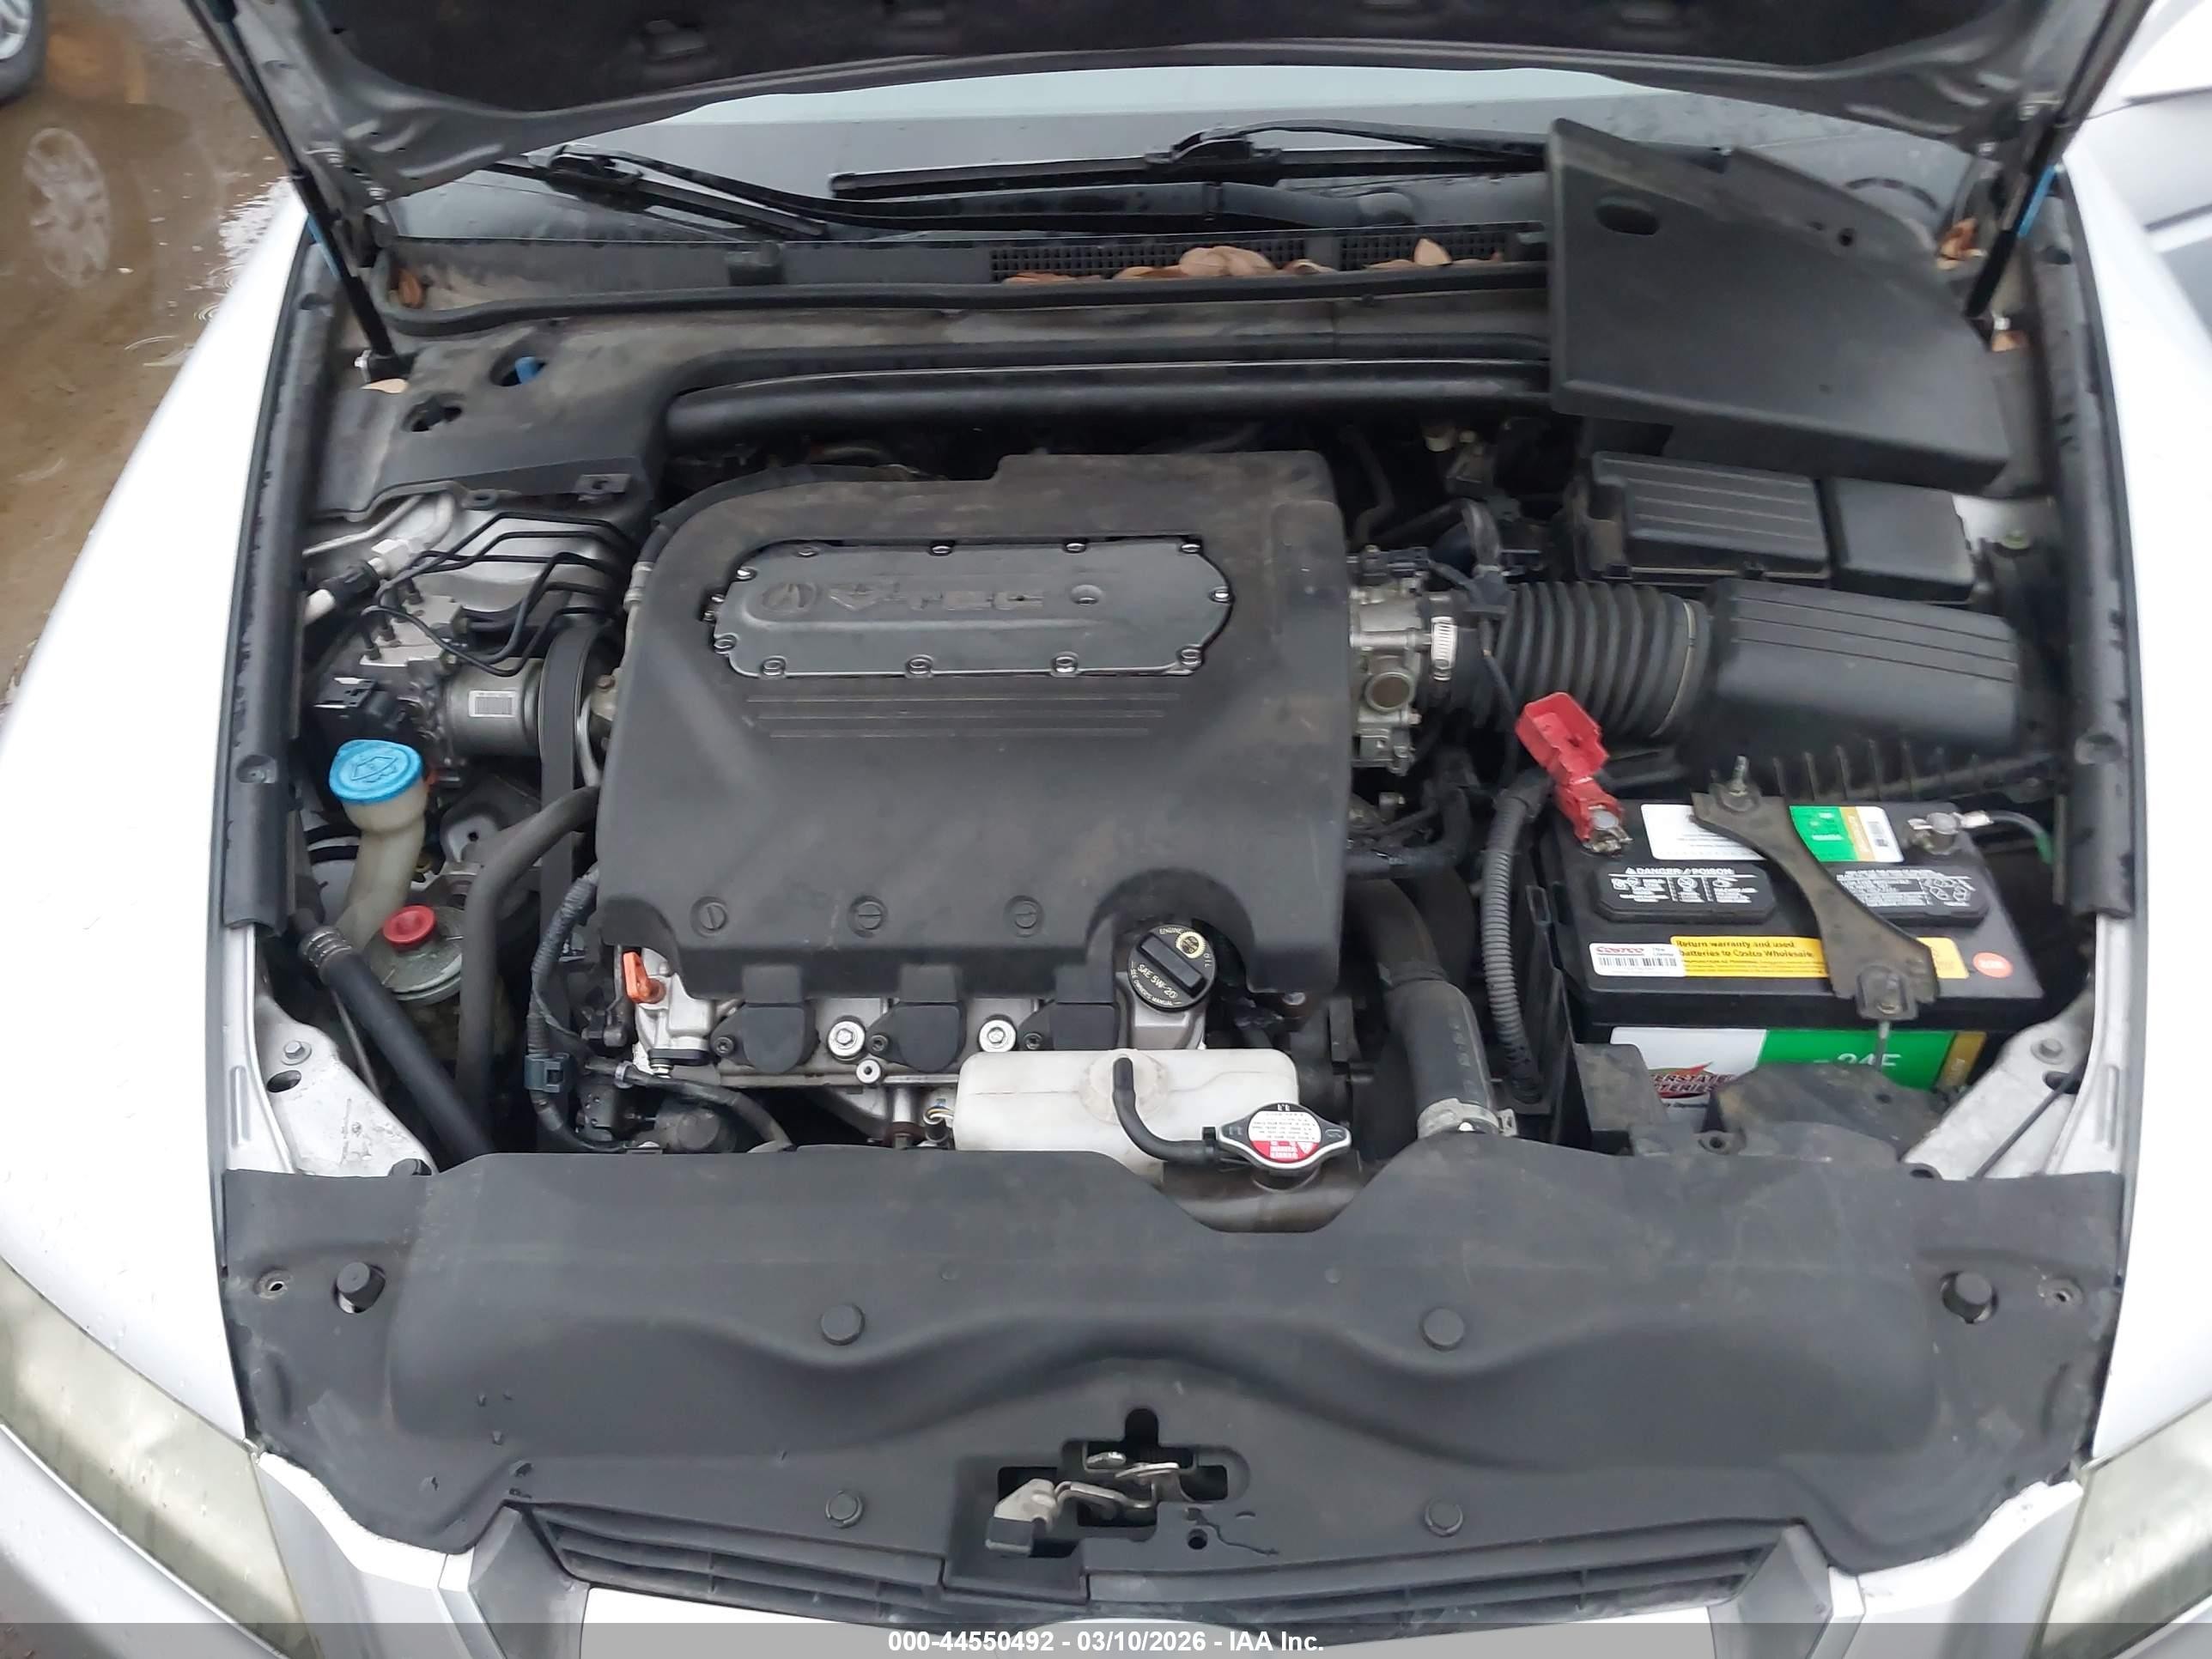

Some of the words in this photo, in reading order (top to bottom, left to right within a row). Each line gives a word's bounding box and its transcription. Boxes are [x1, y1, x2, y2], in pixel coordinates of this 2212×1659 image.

[1710, 940, 1751, 949] warranty
[1203, 952, 1213, 968] OIL
[1137, 963, 1154, 978] SAE
[1152, 996, 1174, 1006] MANUAL
